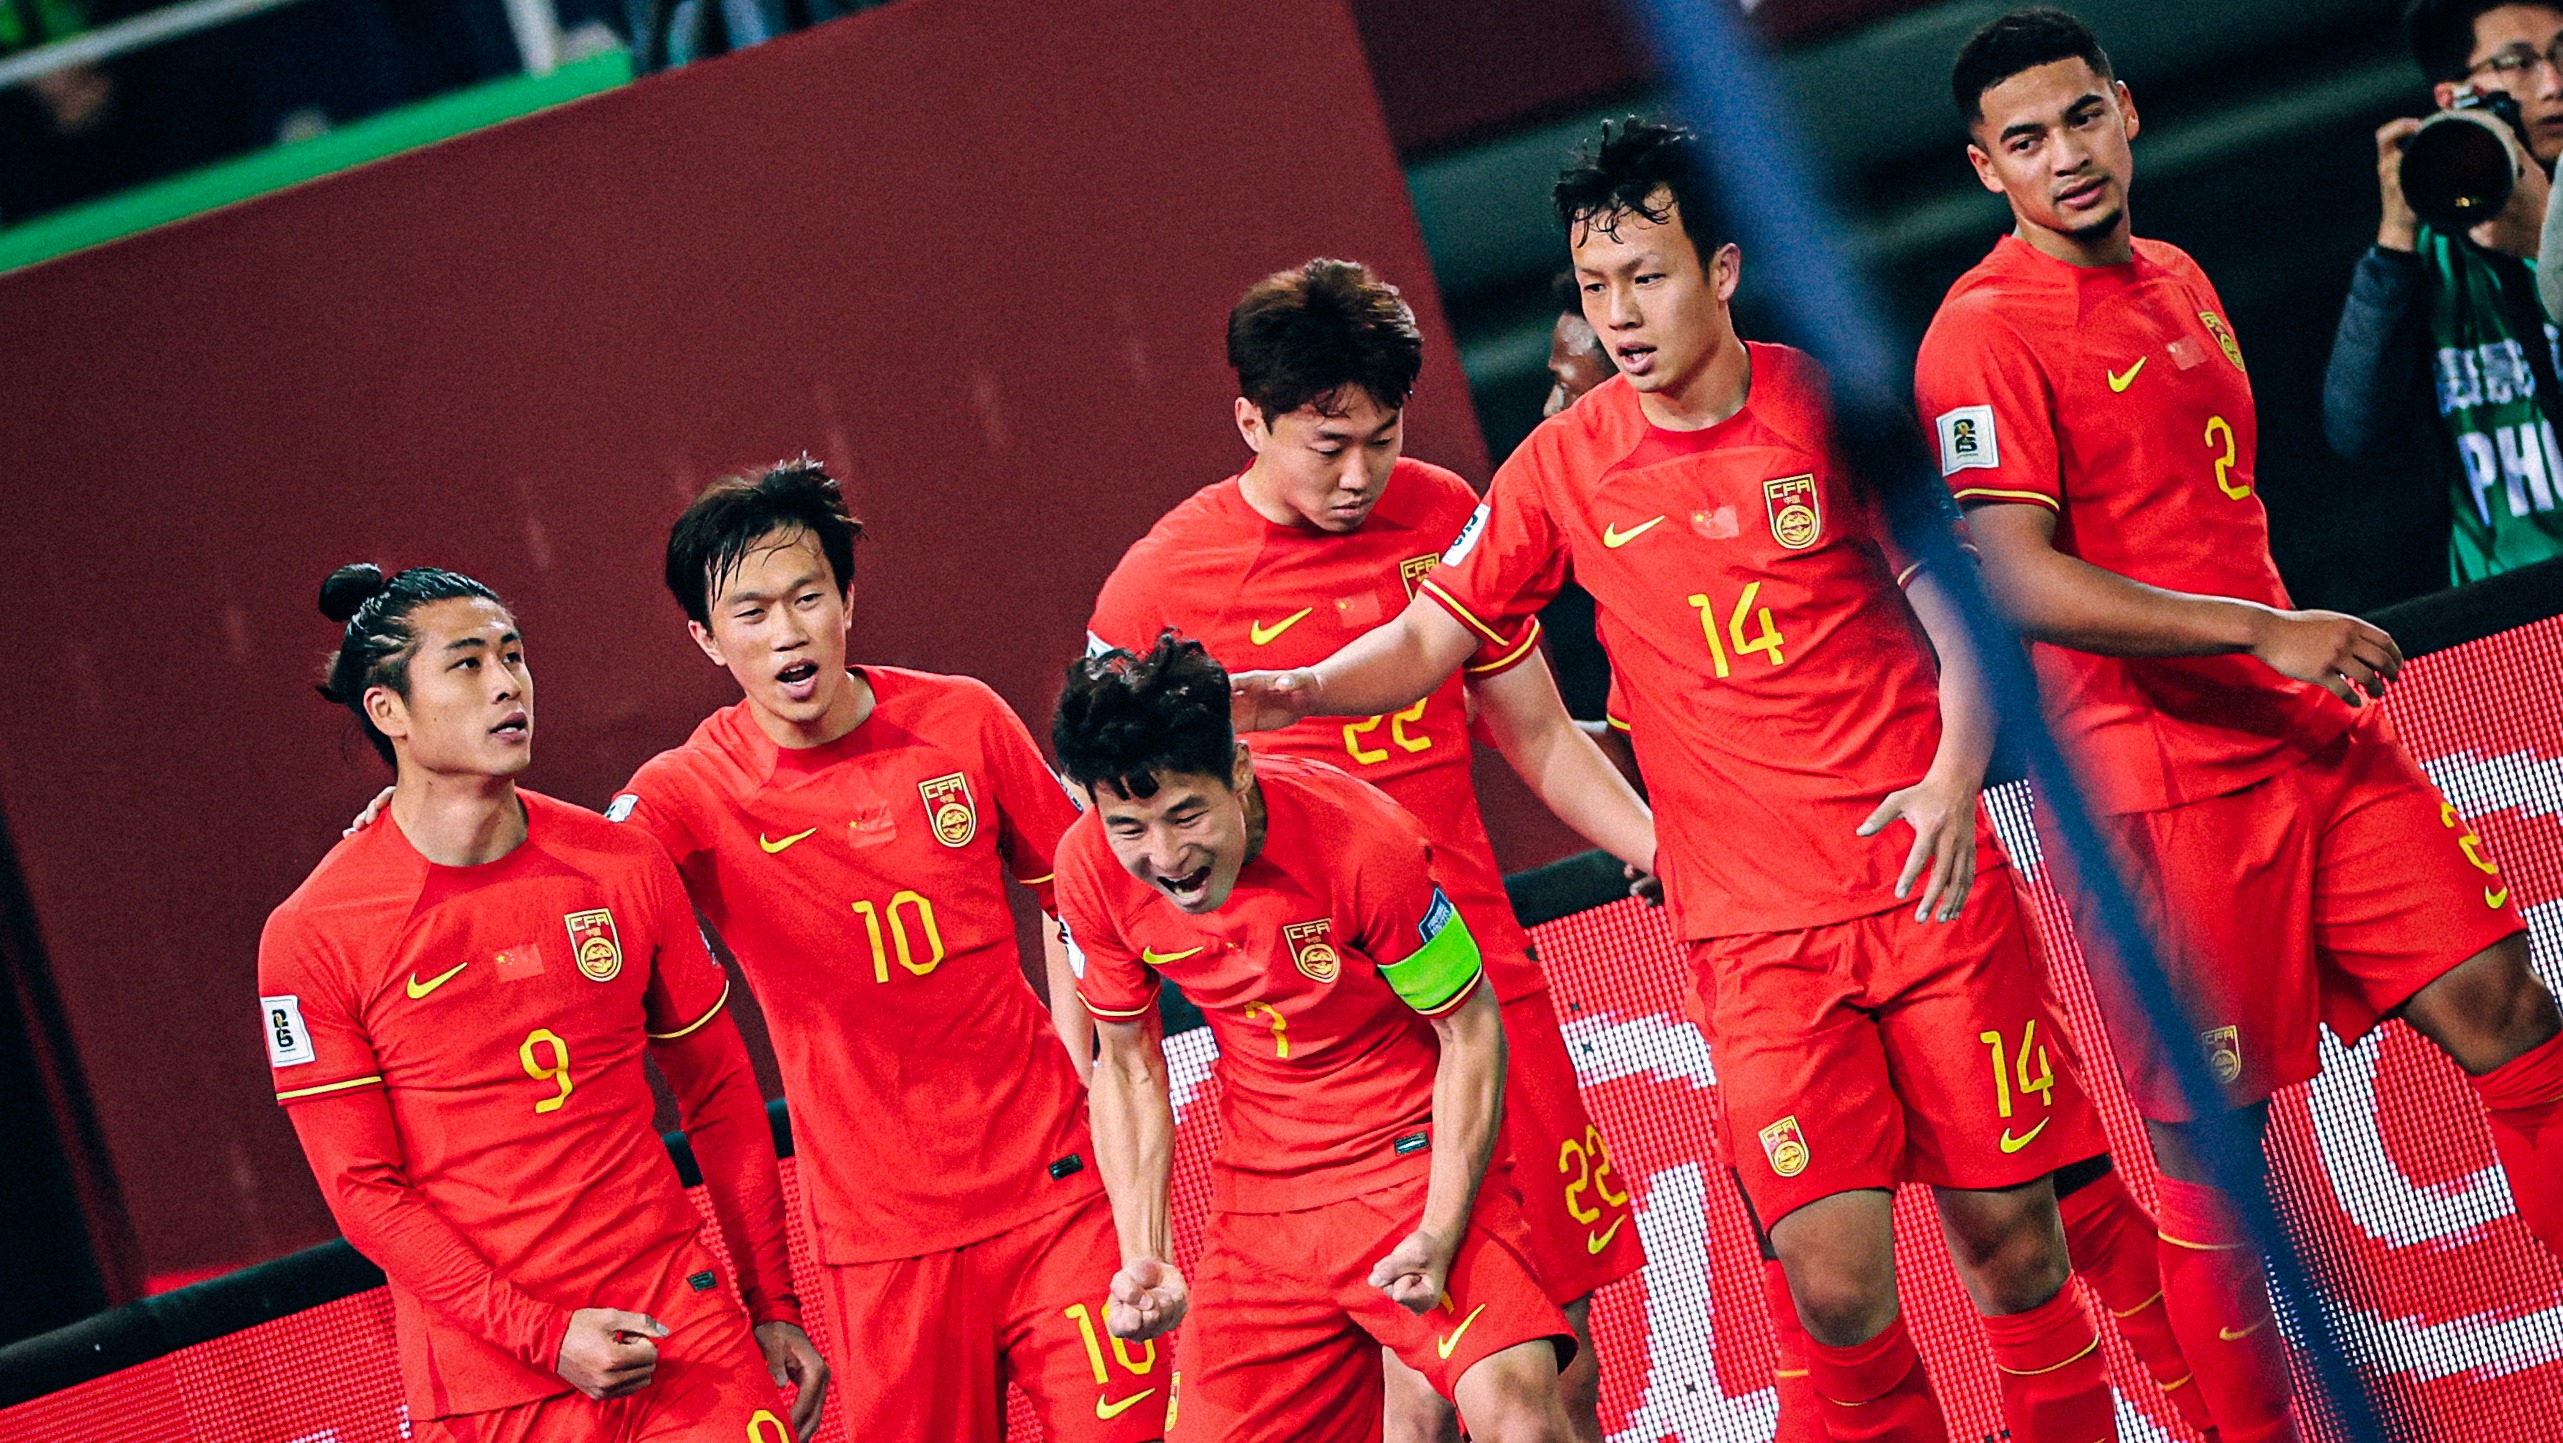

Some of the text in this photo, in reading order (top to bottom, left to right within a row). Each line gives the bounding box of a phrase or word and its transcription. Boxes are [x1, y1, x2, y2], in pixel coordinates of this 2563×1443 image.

[1769, 479, 1811, 499] CFA
[2204, 415, 2251, 501] 2
[1687, 581, 1785, 679] 14
[924, 778, 963, 799] CFA
[570, 913, 609, 932] CFA
[851, 889, 945, 984] 10
[1289, 922, 1331, 940] CFA
[519, 1028, 574, 1114] 9
[1244, 1000, 1290, 1058] 7
[1980, 1019, 2054, 1118] 14
[1559, 1124, 1628, 1225] 22
